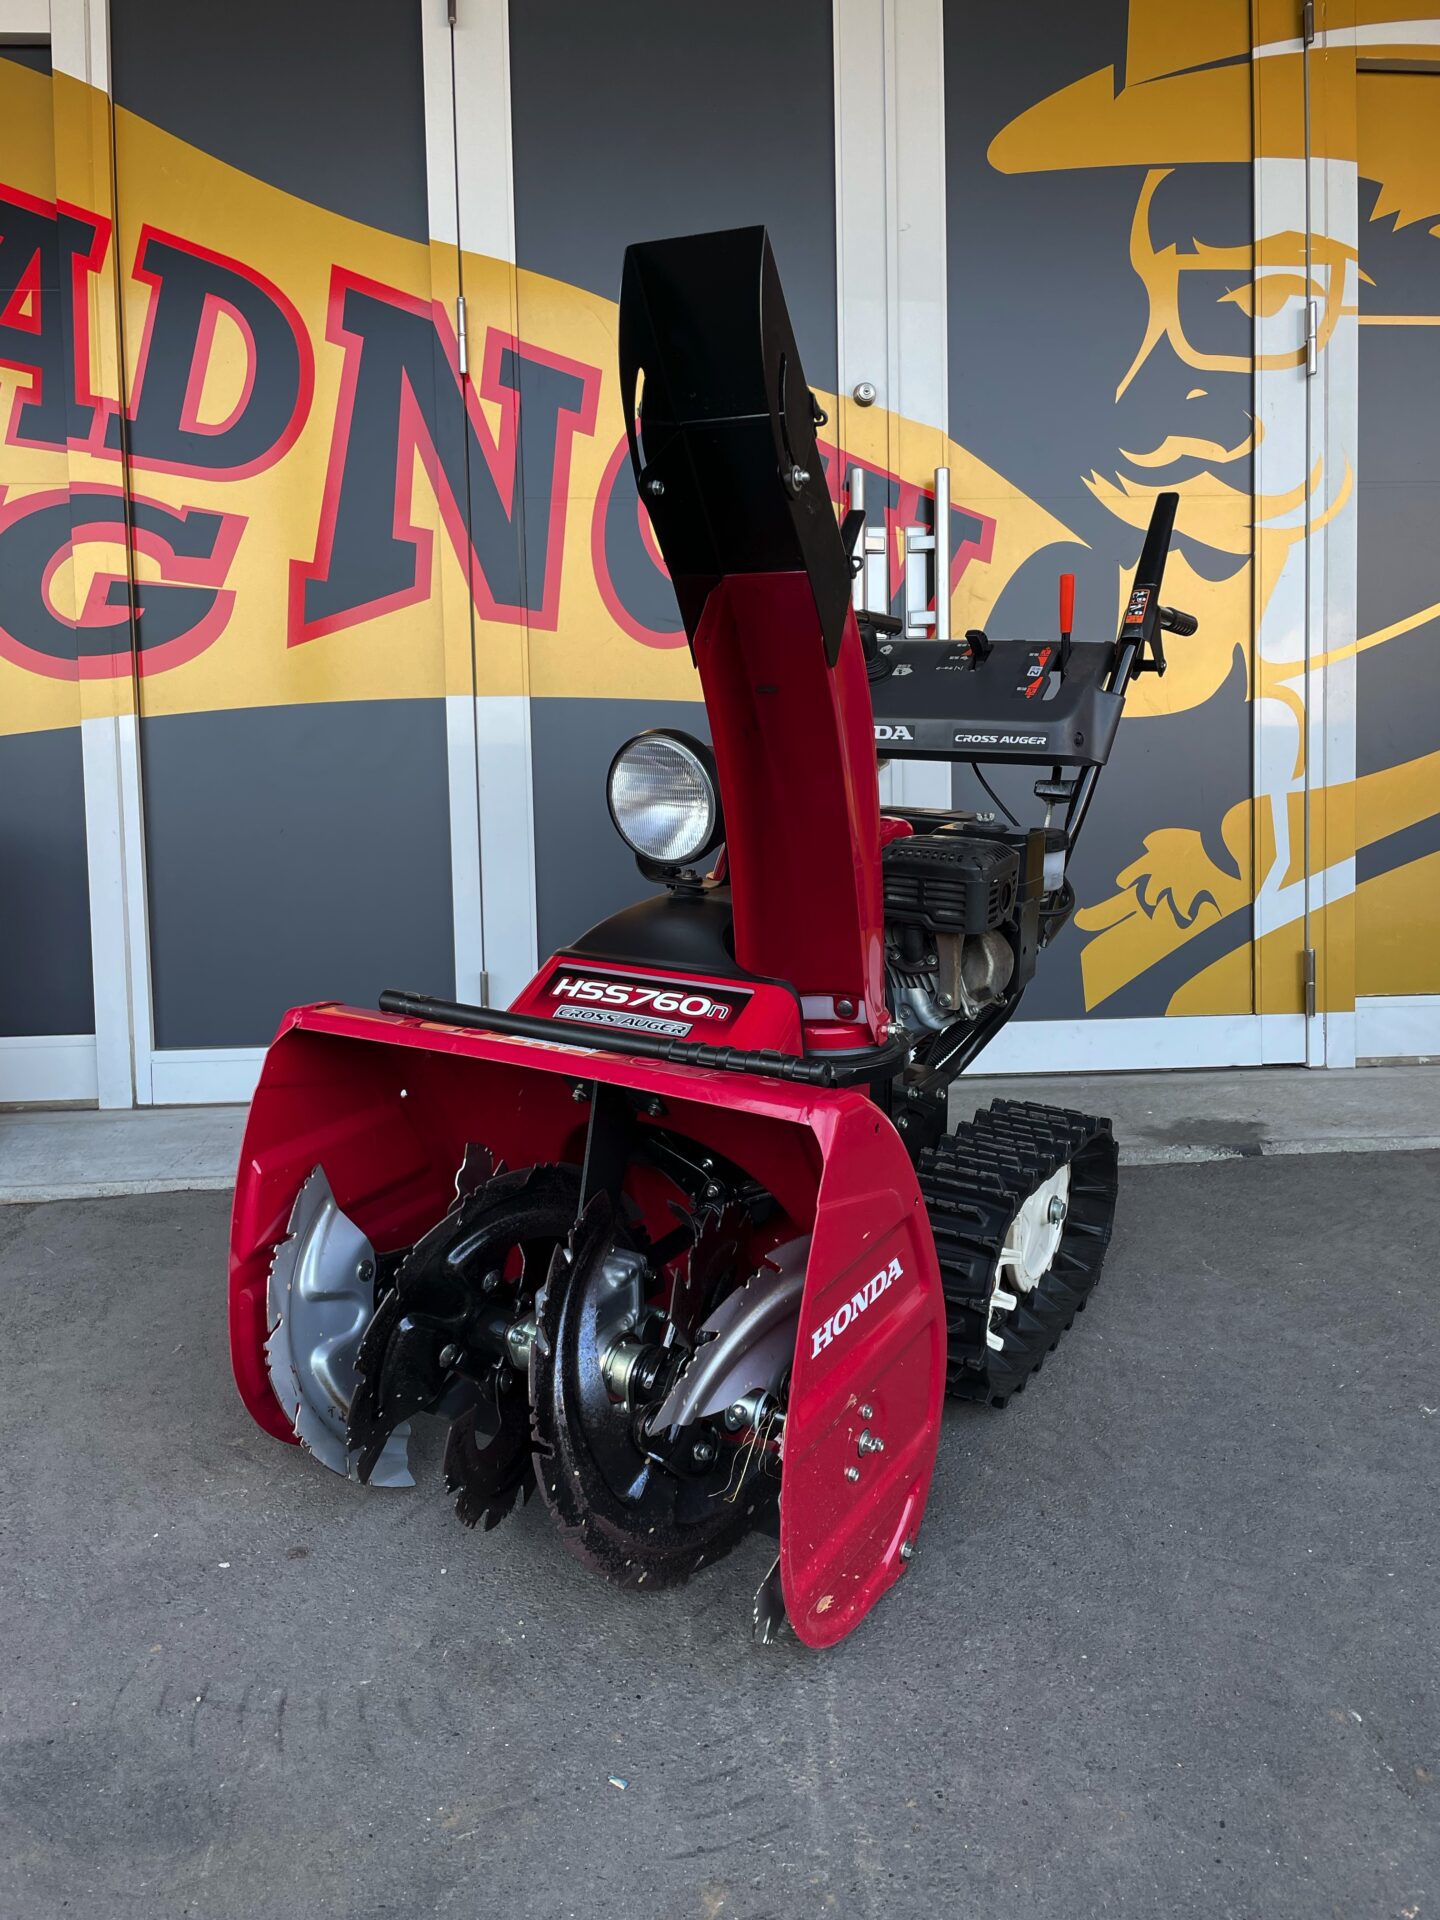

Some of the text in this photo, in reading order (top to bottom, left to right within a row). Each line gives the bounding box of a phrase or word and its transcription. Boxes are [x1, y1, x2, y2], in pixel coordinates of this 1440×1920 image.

[954, 734, 1047, 745] CROSS AUGER
[551, 977, 730, 1020] HSS760n
[557, 1007, 688, 1036] CROSS AUGER
[811, 1257, 904, 1360] HONDA
